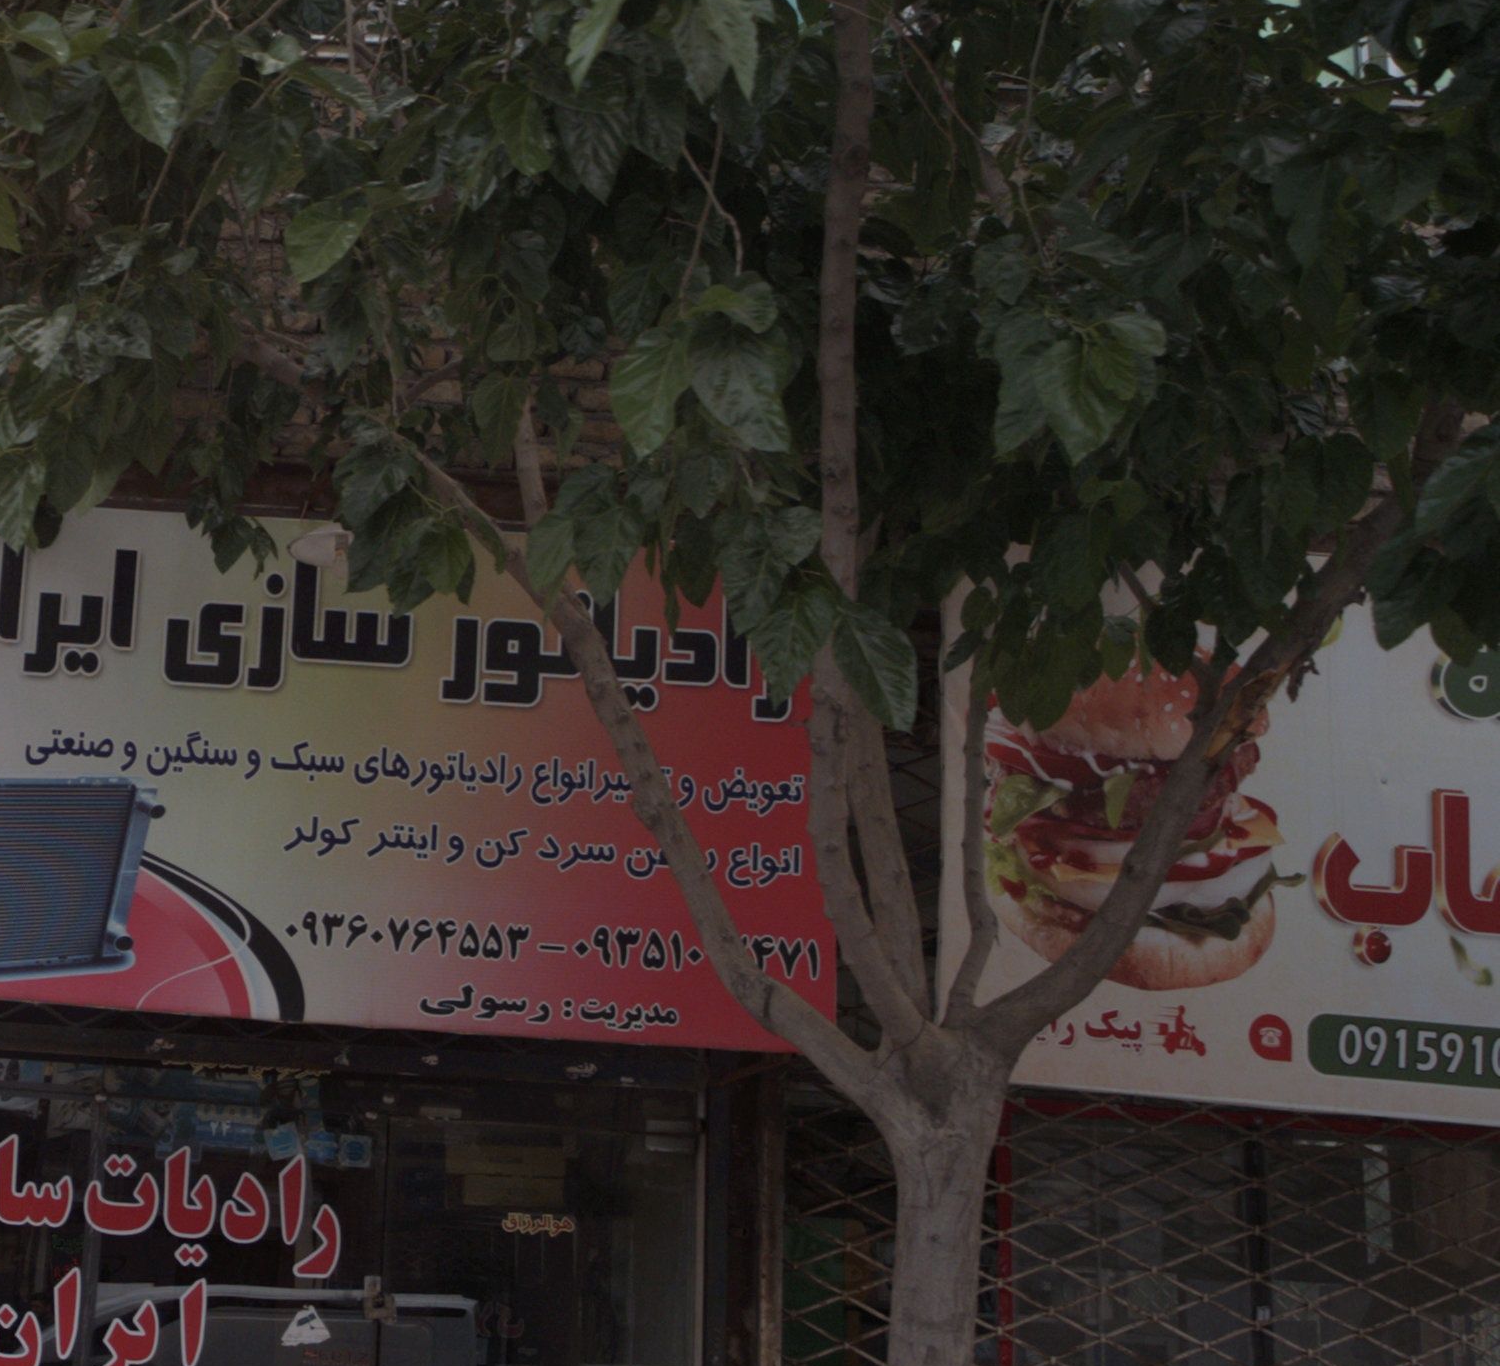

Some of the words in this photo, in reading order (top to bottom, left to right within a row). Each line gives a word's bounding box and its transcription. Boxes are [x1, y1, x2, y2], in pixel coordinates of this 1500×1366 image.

[164, 562, 412, 689] سازی
[25, 727, 114, 766] صنعتی
[121, 743, 136, 771] و
[146, 731, 238, 776] سنگین
[270, 742, 345, 782] سبک
[244, 755, 261, 779] و
[354, 746, 522, 795] رادیاتورهای
[678, 775, 695, 807] و
[705, 768, 804, 816] تعویض
[282, 815, 360, 855] کولر
[366, 825, 437, 862] اینتر
[445, 835, 465, 862] و
[476, 828, 527, 868] کن
[538, 834, 615, 870] سرد
[728, 845, 801, 887] انواع
[1313, 788, 1500, 967] اب
[284, 909, 529, 960] ۰۹۳۶۰۷۶۴۵۵۳
[420, 985, 550, 1023] رسولی
[1085, 1010, 1142, 1052] پیک
[83, 1144, 342, 1278] رادیات
